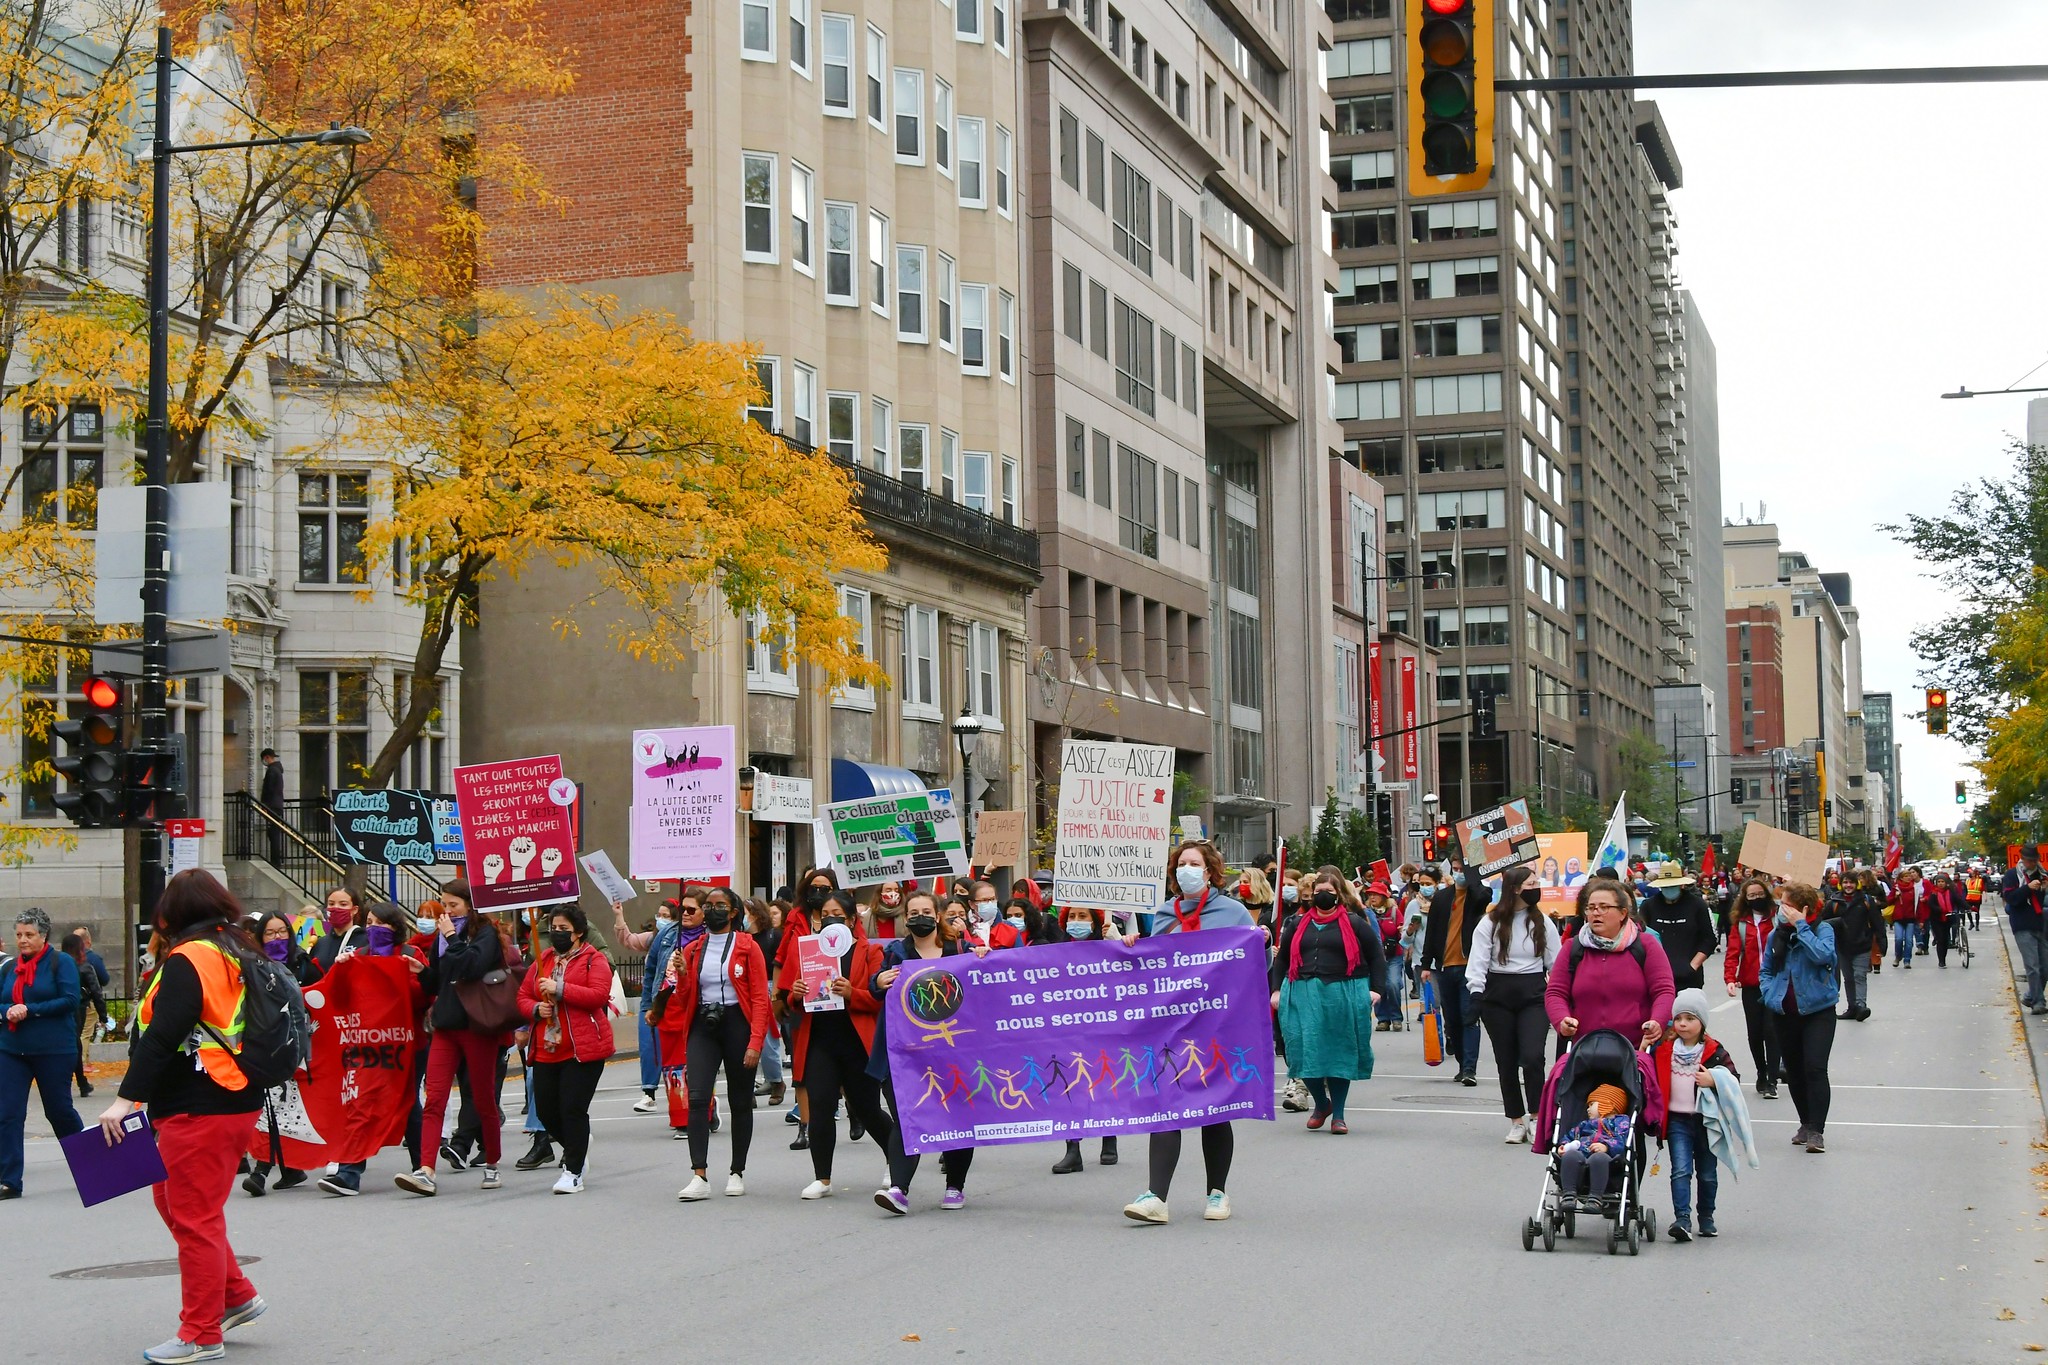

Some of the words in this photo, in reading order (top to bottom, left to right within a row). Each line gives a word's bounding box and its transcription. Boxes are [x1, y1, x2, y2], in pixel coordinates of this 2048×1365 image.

[1063, 745, 1106, 774] ASSEZ
[461, 771, 489, 784] TANT
[491, 769, 513, 781] QUE
[514, 763, 557, 777] TOUTES
[473, 786, 492, 797] LES
[494, 780, 535, 795] FEMMES
[536, 778, 549, 789] NE
[1073, 779, 1146, 808] JUSTICE
[337, 791, 388, 810] Liberté,
[436, 799, 443, 811] à
[444, 800, 453, 811] la
[482, 795, 522, 810] SERONT
[525, 793, 545, 805] PAS
[647, 797, 658, 806] LA
[662, 796, 687, 806] LUTTE
[691, 794, 723, 804] CONTRE
[780, 796, 810, 809] TEALICIOUS
[516, 809, 528, 820] LE
[657, 808, 668, 816] LA
[672, 806, 713, 816] VIOLENCE
[828, 808, 847, 821] Le
[849, 801, 897, 818] climat
[896, 808, 955, 824] change.
[1100, 807, 1126, 822] FILLES
[1128, 812, 1135, 822] et
[1466, 807, 1505, 828] DIVERSITÉ
[352, 815, 418, 834] solidarité
[475, 828, 500, 840] SERA
[503, 825, 515, 836] EN
[518, 819, 560, 834] MARCHE!
[659, 818, 692, 827] ENVERS
[695, 816, 711, 825] LES
[980, 818, 997, 833] WE
[997, 819, 1016, 833] HAVE
[443, 832, 460, 843] des
[667, 827, 703, 837] FEMMES
[840, 827, 895, 845] Pourquoi
[1063, 823, 1099, 839] FEMMES
[1101, 824, 1166, 841] AUTOCHTONES
[1487, 828, 1515, 844] ÉQUITÉ
[1517, 824, 1527, 835] ET
[386, 841, 432, 861] égalité,
[844, 852, 866, 866] pas
[868, 847, 880, 860] le
[986, 841, 1017, 857] VOICE
[1109, 845, 1140, 858] CONTRE
[1144, 846, 1153, 859] LE
[1060, 861, 1101, 878] RACISME
[1107, 860, 1164, 880] SYSTÉMIQUE
[1479, 852, 1520, 875] INCLUSION
[967, 967, 1017, 985] Tant
[1023, 966, 1060, 985] que
[1066, 958, 1134, 977] toutes
[1137, 956, 1167, 970] les
[1172, 947, 1246, 967] femmes
[1009, 992, 1036, 1006] ne
[1042, 983, 1108, 1003] seront
[1114, 983, 1148, 1001] pas
[1153, 976, 1209, 994] libres,
[995, 1016, 1045, 1031] nous
[1051, 1009, 1118, 1026] serons
[1123, 1007, 1145, 1021] en
[1151, 993, 1229, 1018] marche!
[920, 1128, 974, 1144] Coalition
[977, 1122, 1051, 1137] montréalaise
[1054, 1121, 1068, 1131] de
[1070, 1120, 1080, 1130] la
[1082, 1116, 1124, 1129] Marche
[1127, 1110, 1179, 1125] mondiale
[1182, 1108, 1205, 1119] des
[1207, 1100, 1254, 1116] femmes
